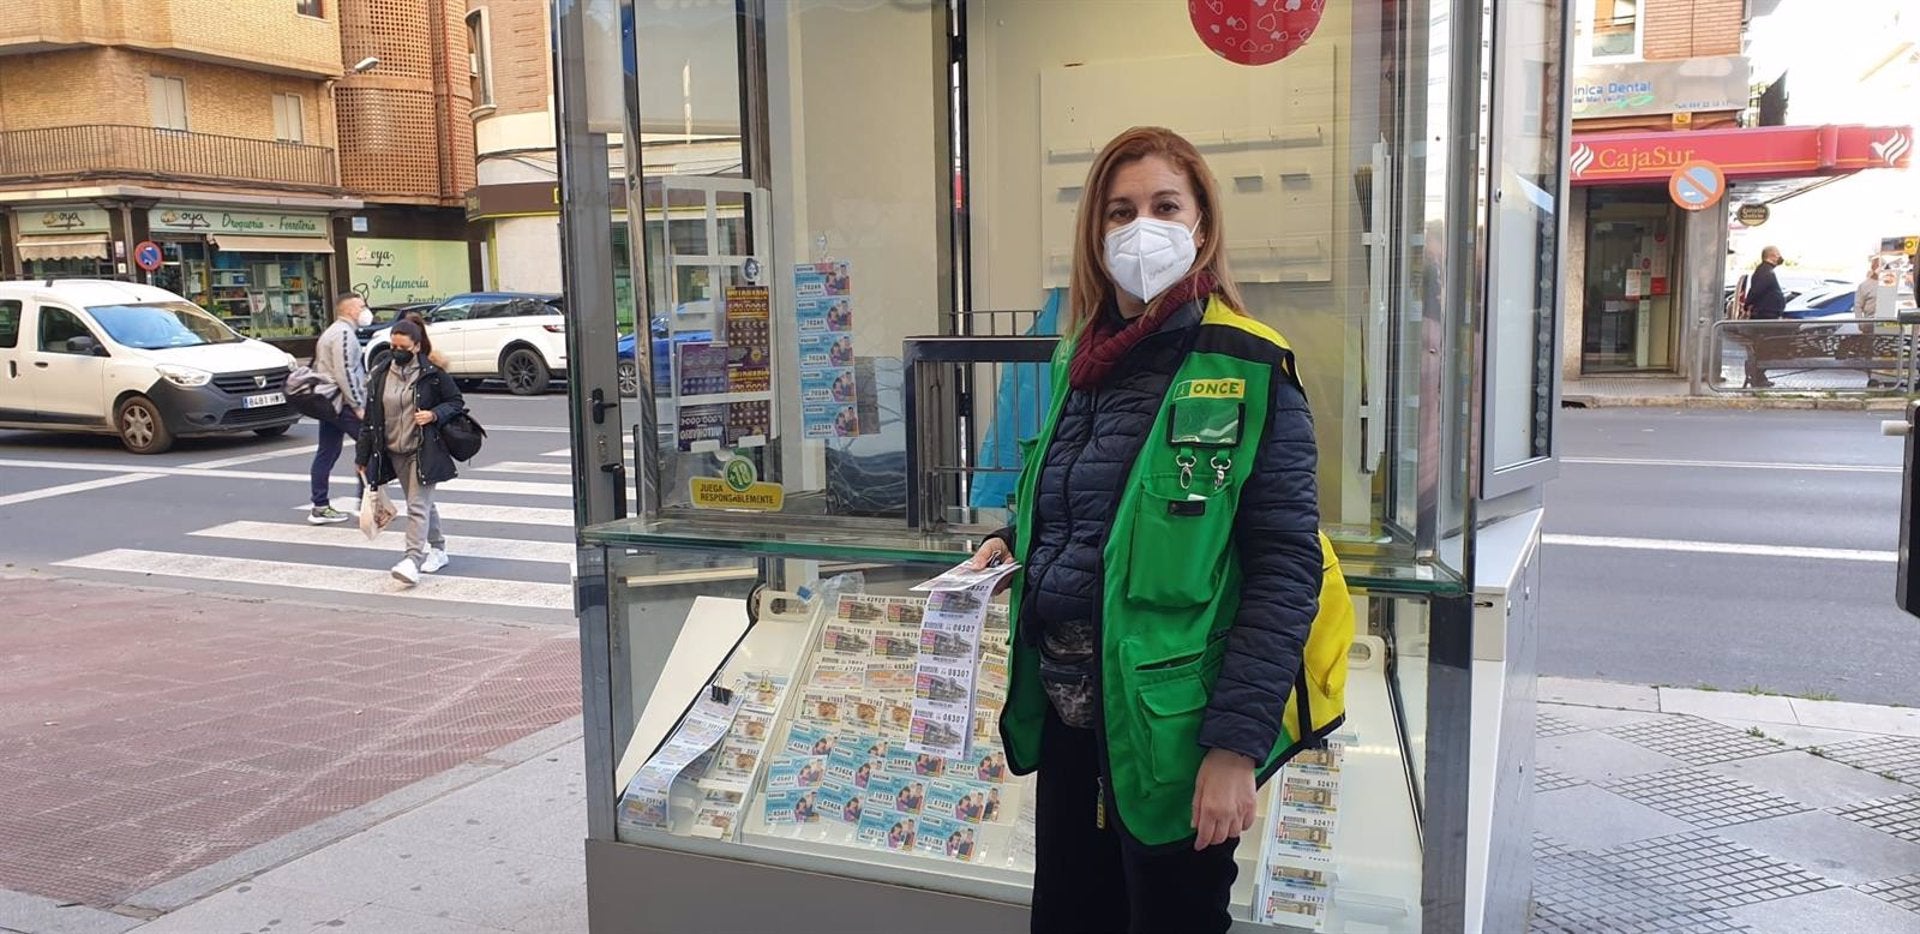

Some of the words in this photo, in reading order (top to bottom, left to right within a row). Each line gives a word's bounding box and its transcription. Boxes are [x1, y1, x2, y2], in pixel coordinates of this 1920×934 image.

[1608, 81, 1651, 93] Dental
[1599, 146, 1695, 172] CajaSur
[372, 275, 430, 294] Perfumería
[1193, 382, 1240, 394] ONCE
[729, 462, 751, 486] +18
[700, 484, 723, 493] JUEGA
[700, 493, 774, 504] RESPONSABLEMENTE
